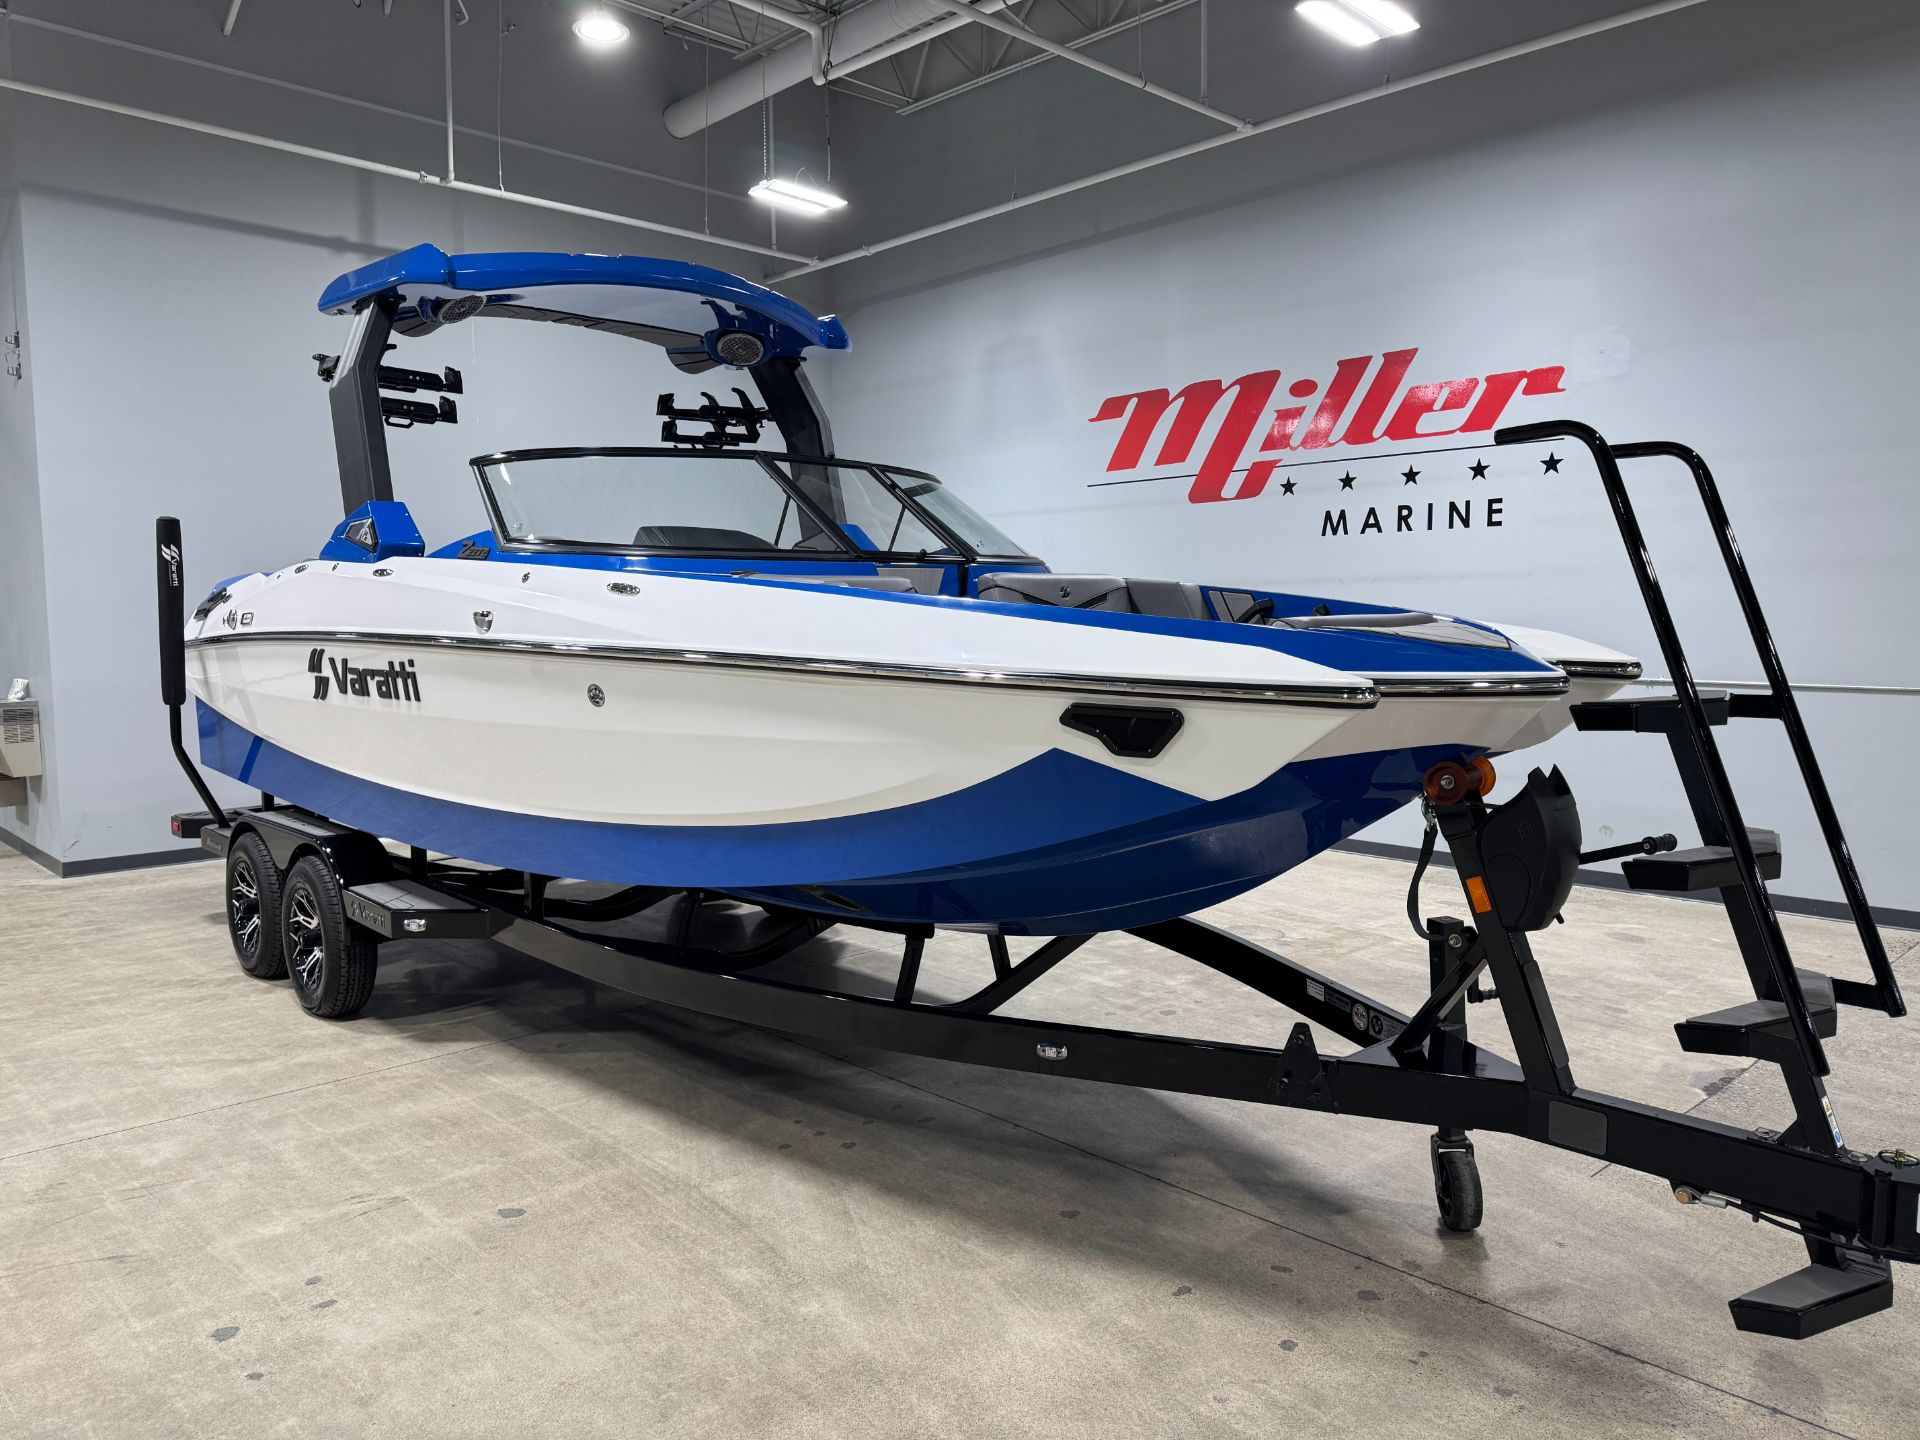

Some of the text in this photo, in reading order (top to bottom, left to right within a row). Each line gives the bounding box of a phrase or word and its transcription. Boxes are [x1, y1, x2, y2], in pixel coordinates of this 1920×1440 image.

[1088, 348, 1566, 504] Miller
[1320, 497, 1504, 537] MARINE
[170, 558, 180, 587] Varatti
[328, 657, 422, 702] Varatti
